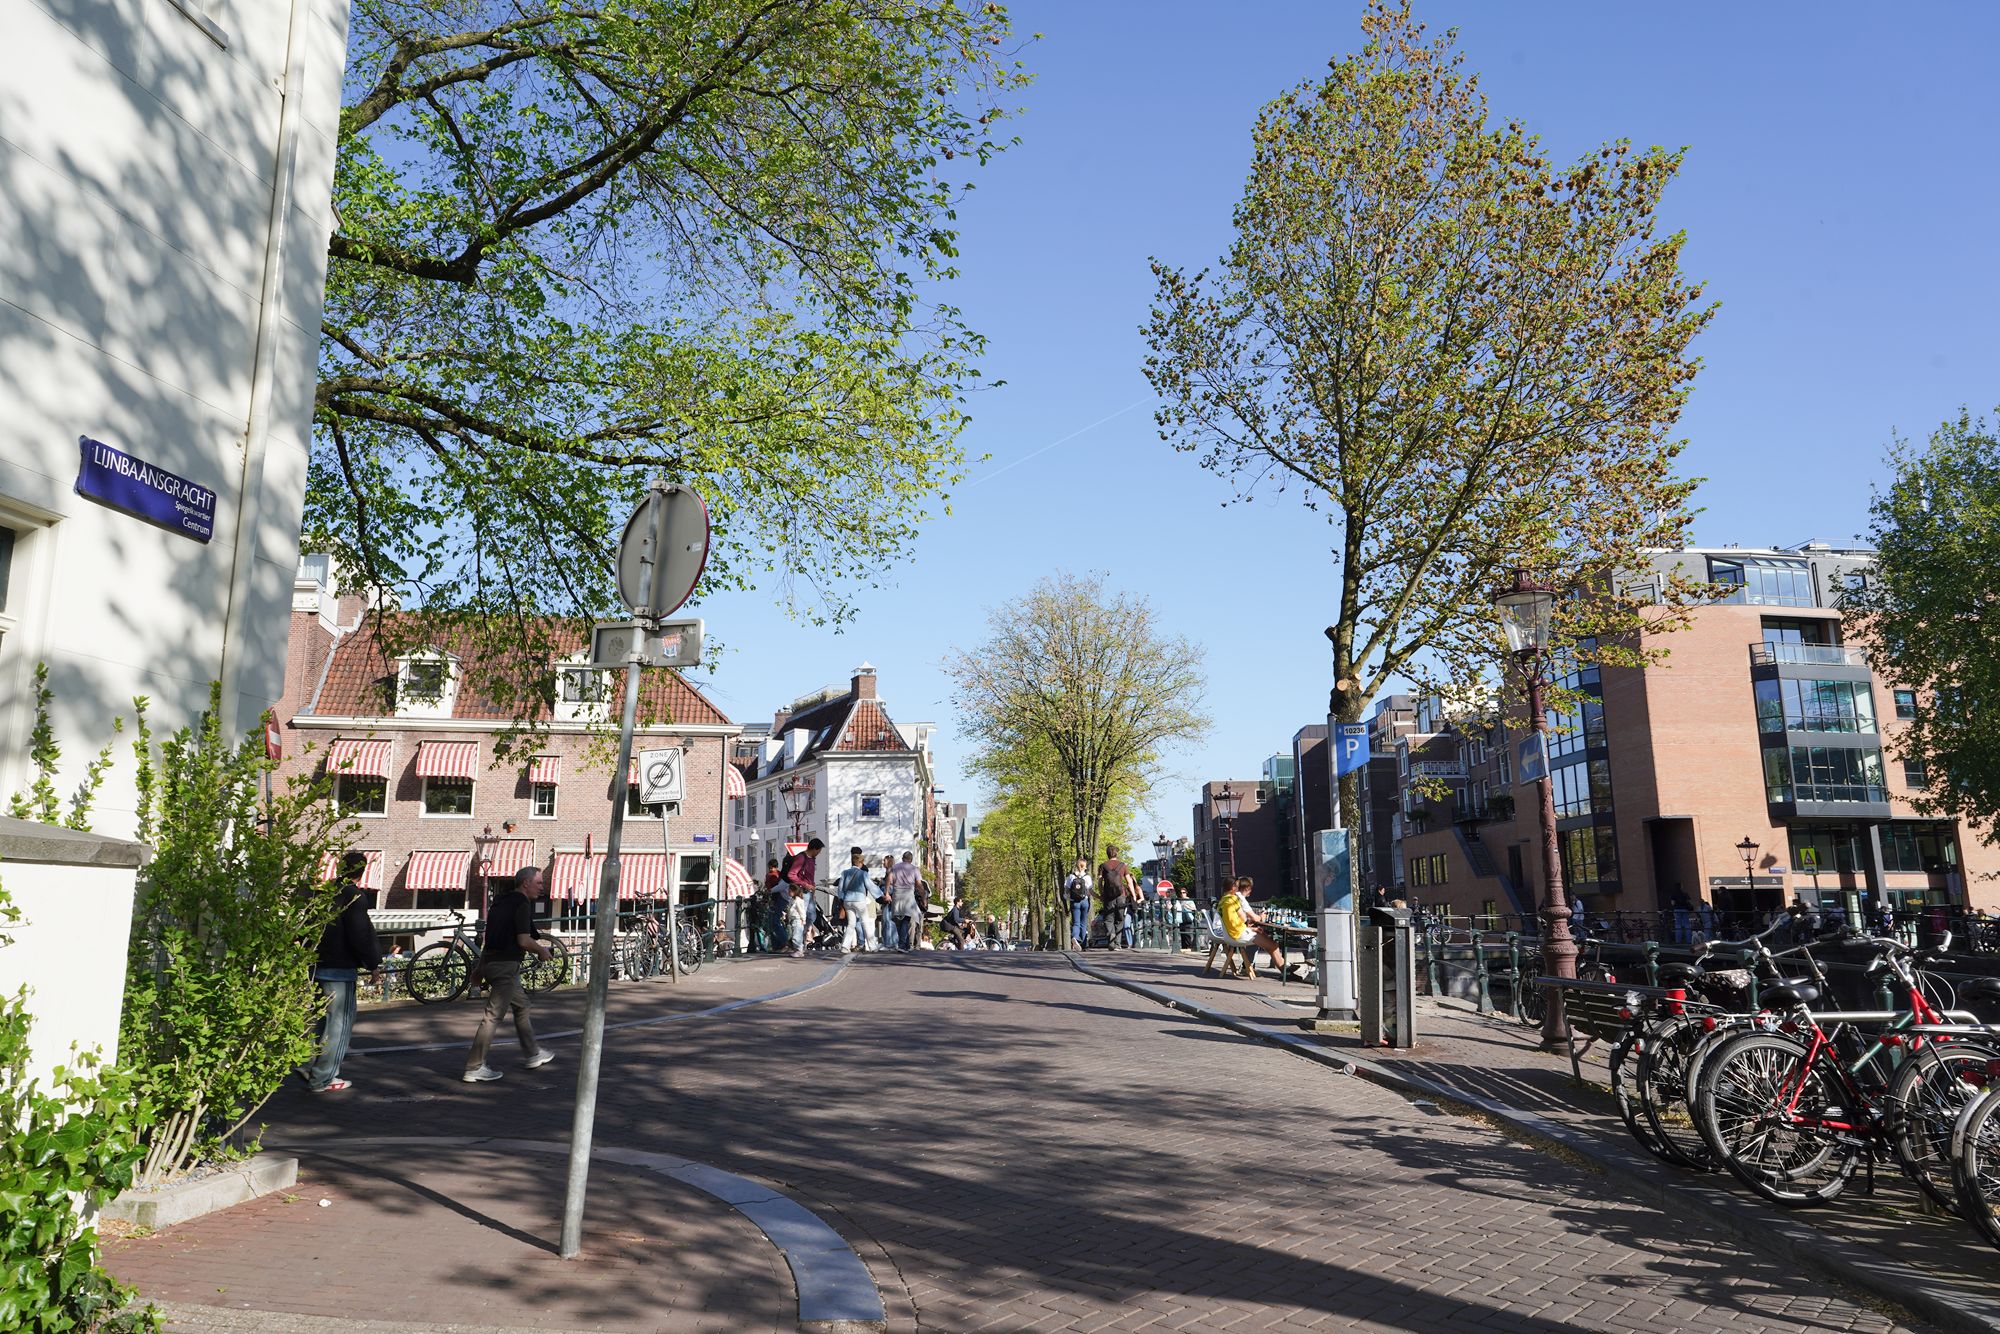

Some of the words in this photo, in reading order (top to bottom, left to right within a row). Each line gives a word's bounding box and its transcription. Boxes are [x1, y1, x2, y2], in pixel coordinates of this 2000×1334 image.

[94, 445, 214, 511] LIJNBAANSGRACHT
[175, 500, 211, 522] Spiegelkwartier
[182, 516, 210, 536] Centrum
[1345, 726, 1365, 734] 10236
[1346, 738, 1360, 759] P
